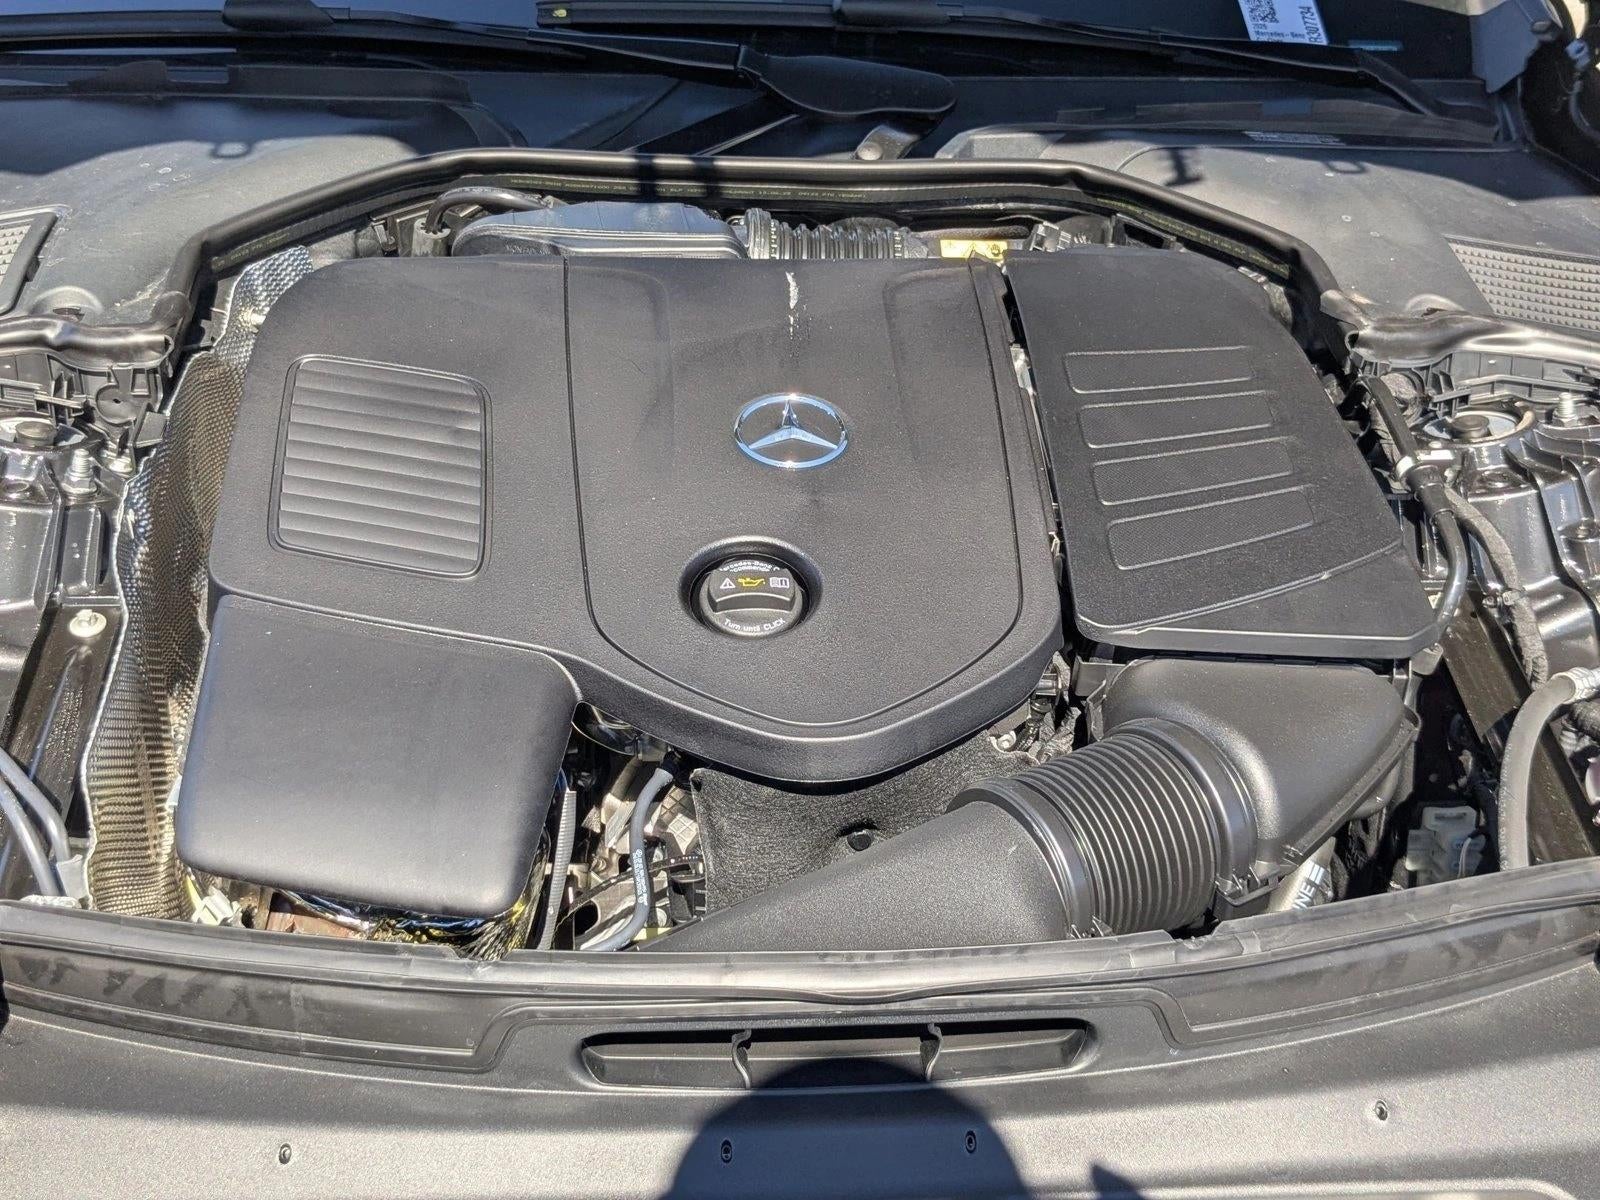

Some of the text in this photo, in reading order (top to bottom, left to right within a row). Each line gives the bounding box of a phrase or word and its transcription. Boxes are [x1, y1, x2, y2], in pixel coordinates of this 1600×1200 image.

[724, 617, 786, 632] Turn until CLICK
